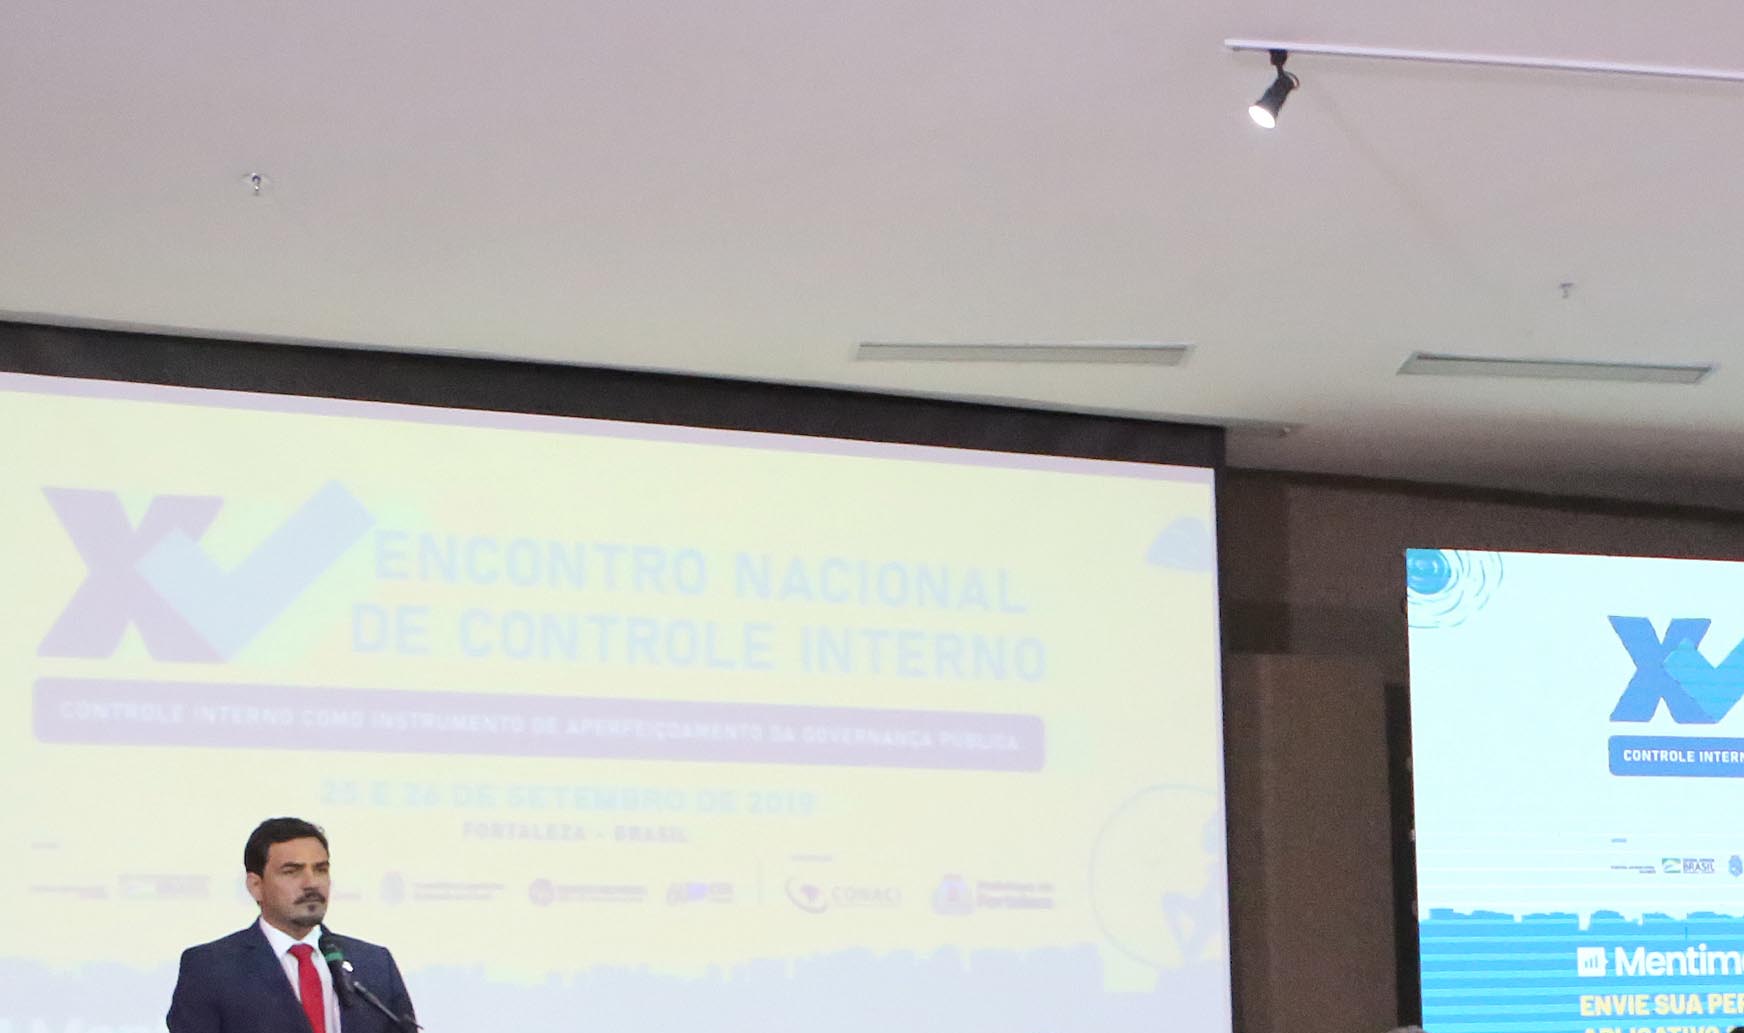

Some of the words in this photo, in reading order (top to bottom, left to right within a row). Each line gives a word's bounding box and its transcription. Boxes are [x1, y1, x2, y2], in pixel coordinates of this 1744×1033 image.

[374, 529, 708, 597] ENCONTRO
[736, 552, 1030, 615] NACIONAL
[352, 603, 431, 655] DE
[458, 609, 776, 671] CONTROLE
[801, 625, 1047, 683] INTERNO
[60, 700, 183, 724] CONTROLE
[193, 703, 295, 726] INTERNO
[303, 708, 364, 729] COMO
[372, 712, 525, 733] INSTRUMENTO
[532, 717, 558, 735] DE
[770, 723, 795, 743] DA
[1623, 749, 1696, 763] CONTROLE
[452, 783, 496, 809] DE
[507, 784, 685, 813] SETEMBRO
[699, 789, 737, 813] DE
[463, 820, 587, 842] FORTALEZA
[614, 825, 689, 843] BRASIL
[1683, 862, 1715, 872] BRASIL
[1580, 993, 1649, 1017] ENVIE
[1654, 993, 1703, 1015] SUA
